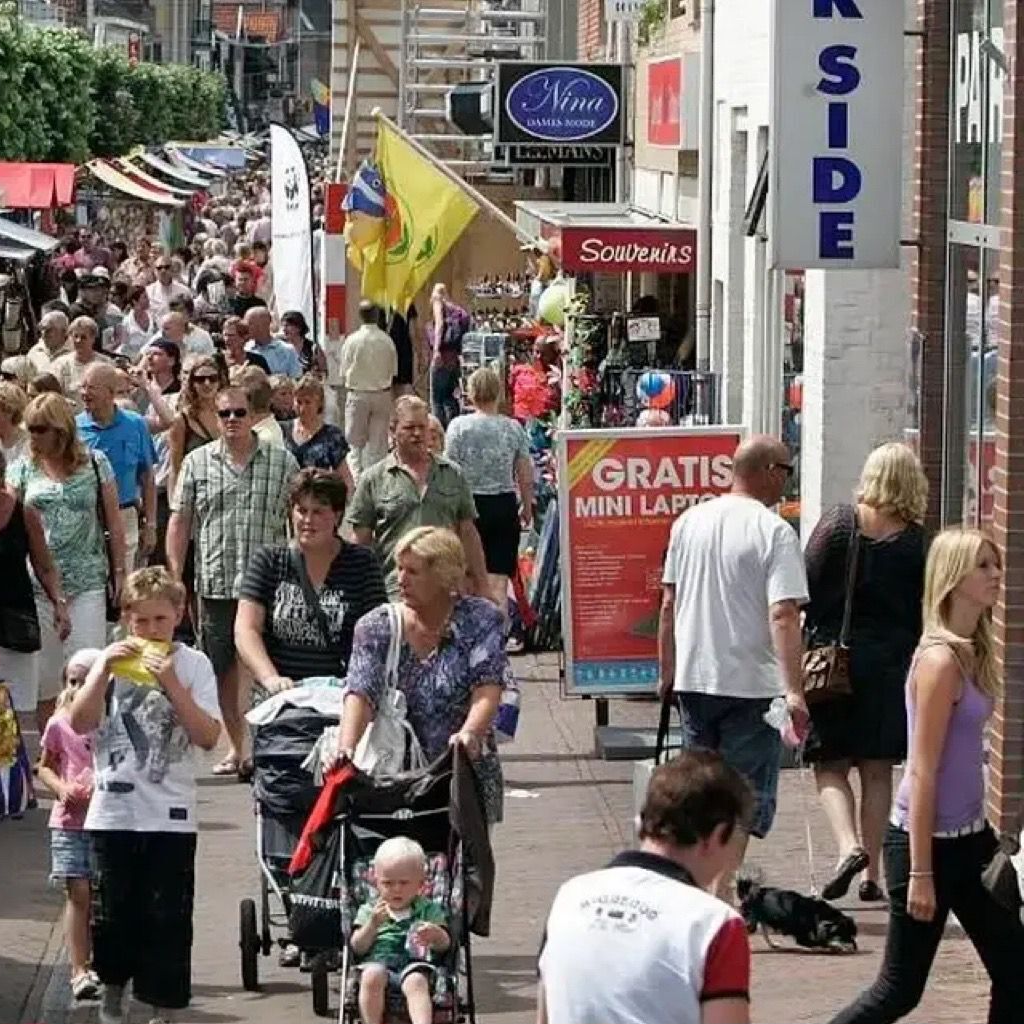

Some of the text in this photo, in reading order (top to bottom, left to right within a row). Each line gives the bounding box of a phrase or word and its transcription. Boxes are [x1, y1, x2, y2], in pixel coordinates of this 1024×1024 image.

[521, 76, 605, 114] Nina
[565, 119, 596, 128] MODE
[579, 238, 692, 265] Souvenirs
[592, 455, 733, 491] GRATIS
[576, 496, 632, 517] MINI
